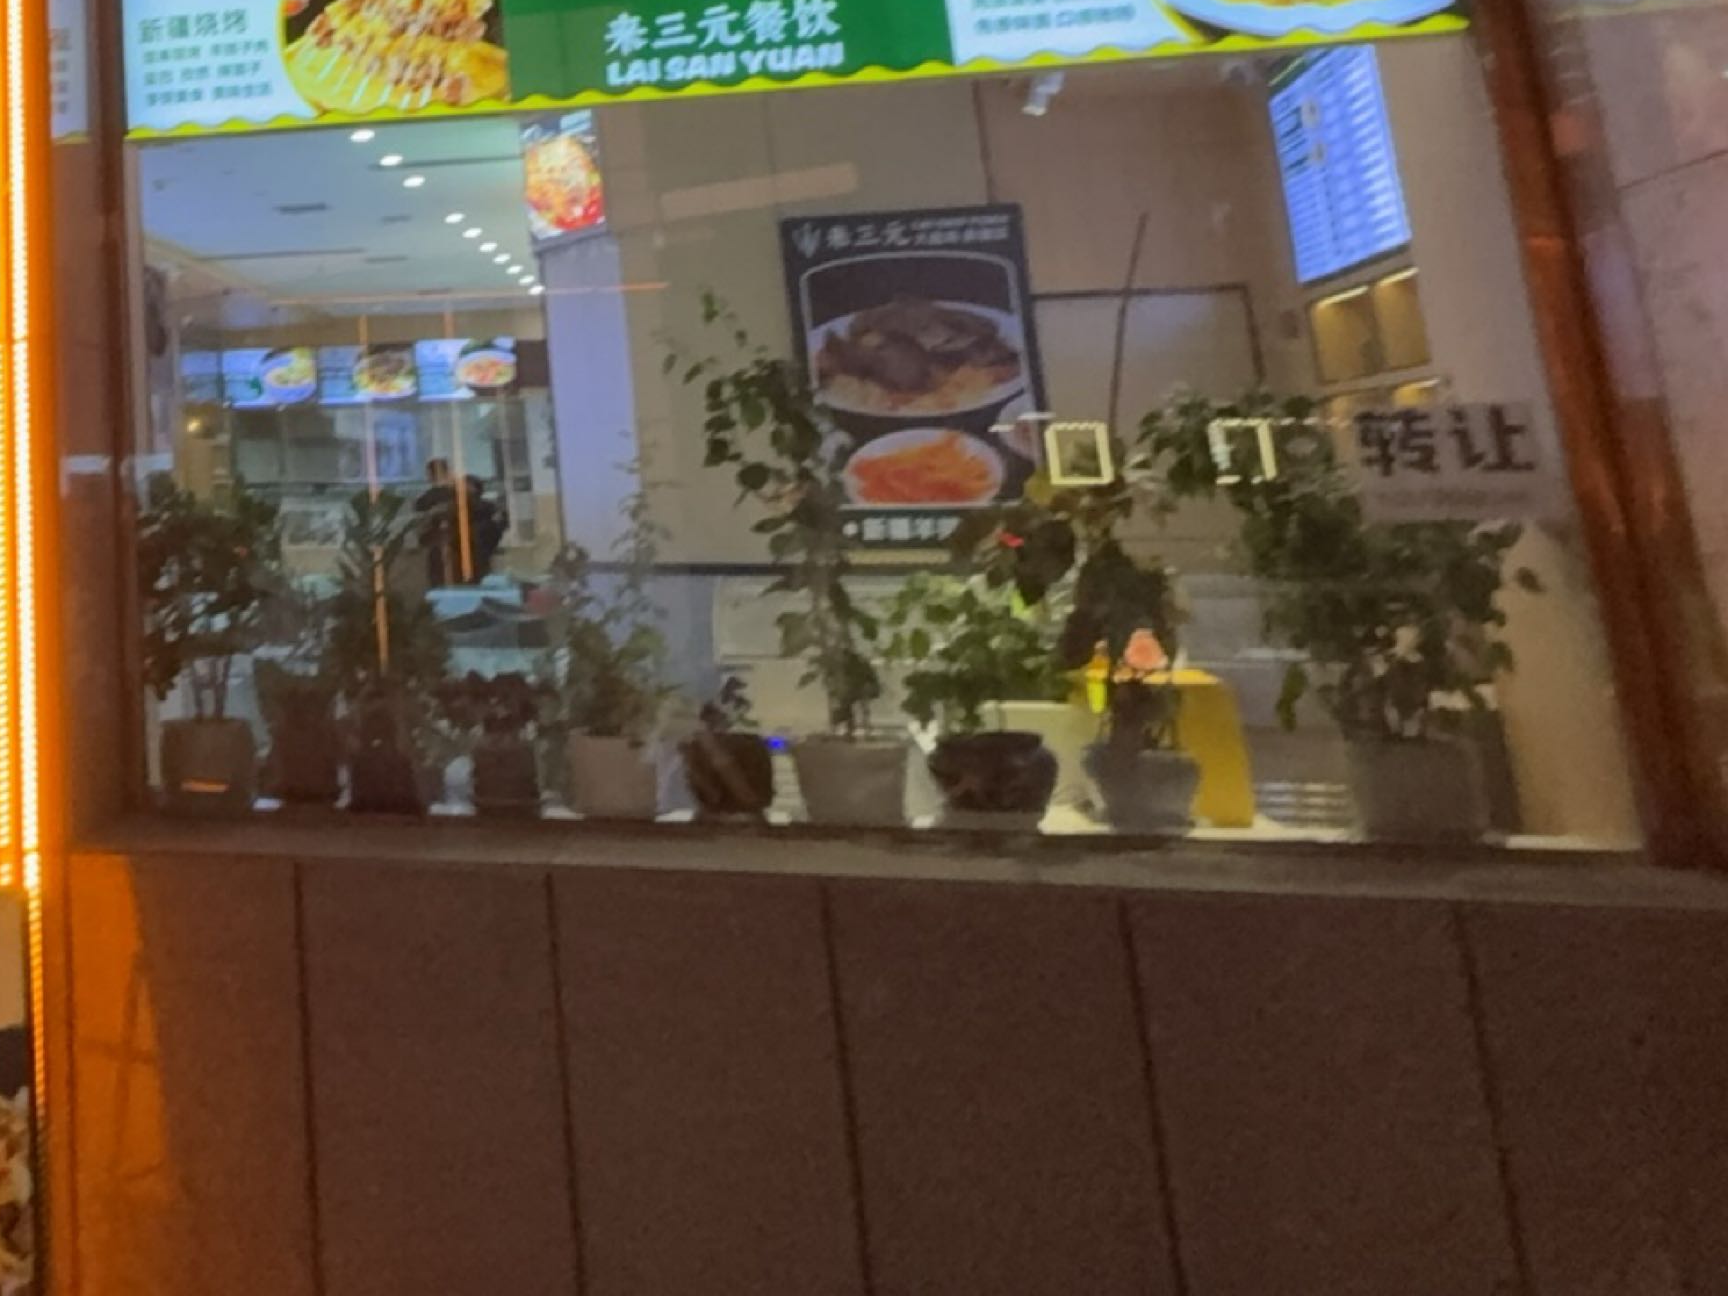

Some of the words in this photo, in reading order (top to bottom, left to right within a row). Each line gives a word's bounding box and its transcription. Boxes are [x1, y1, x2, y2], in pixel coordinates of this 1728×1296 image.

[605, 57, 662, 88] LAI
[671, 53, 737, 83] SAN
[740, 41, 846, 75] YUAN
[1353, 403, 1536, 477] 转让
